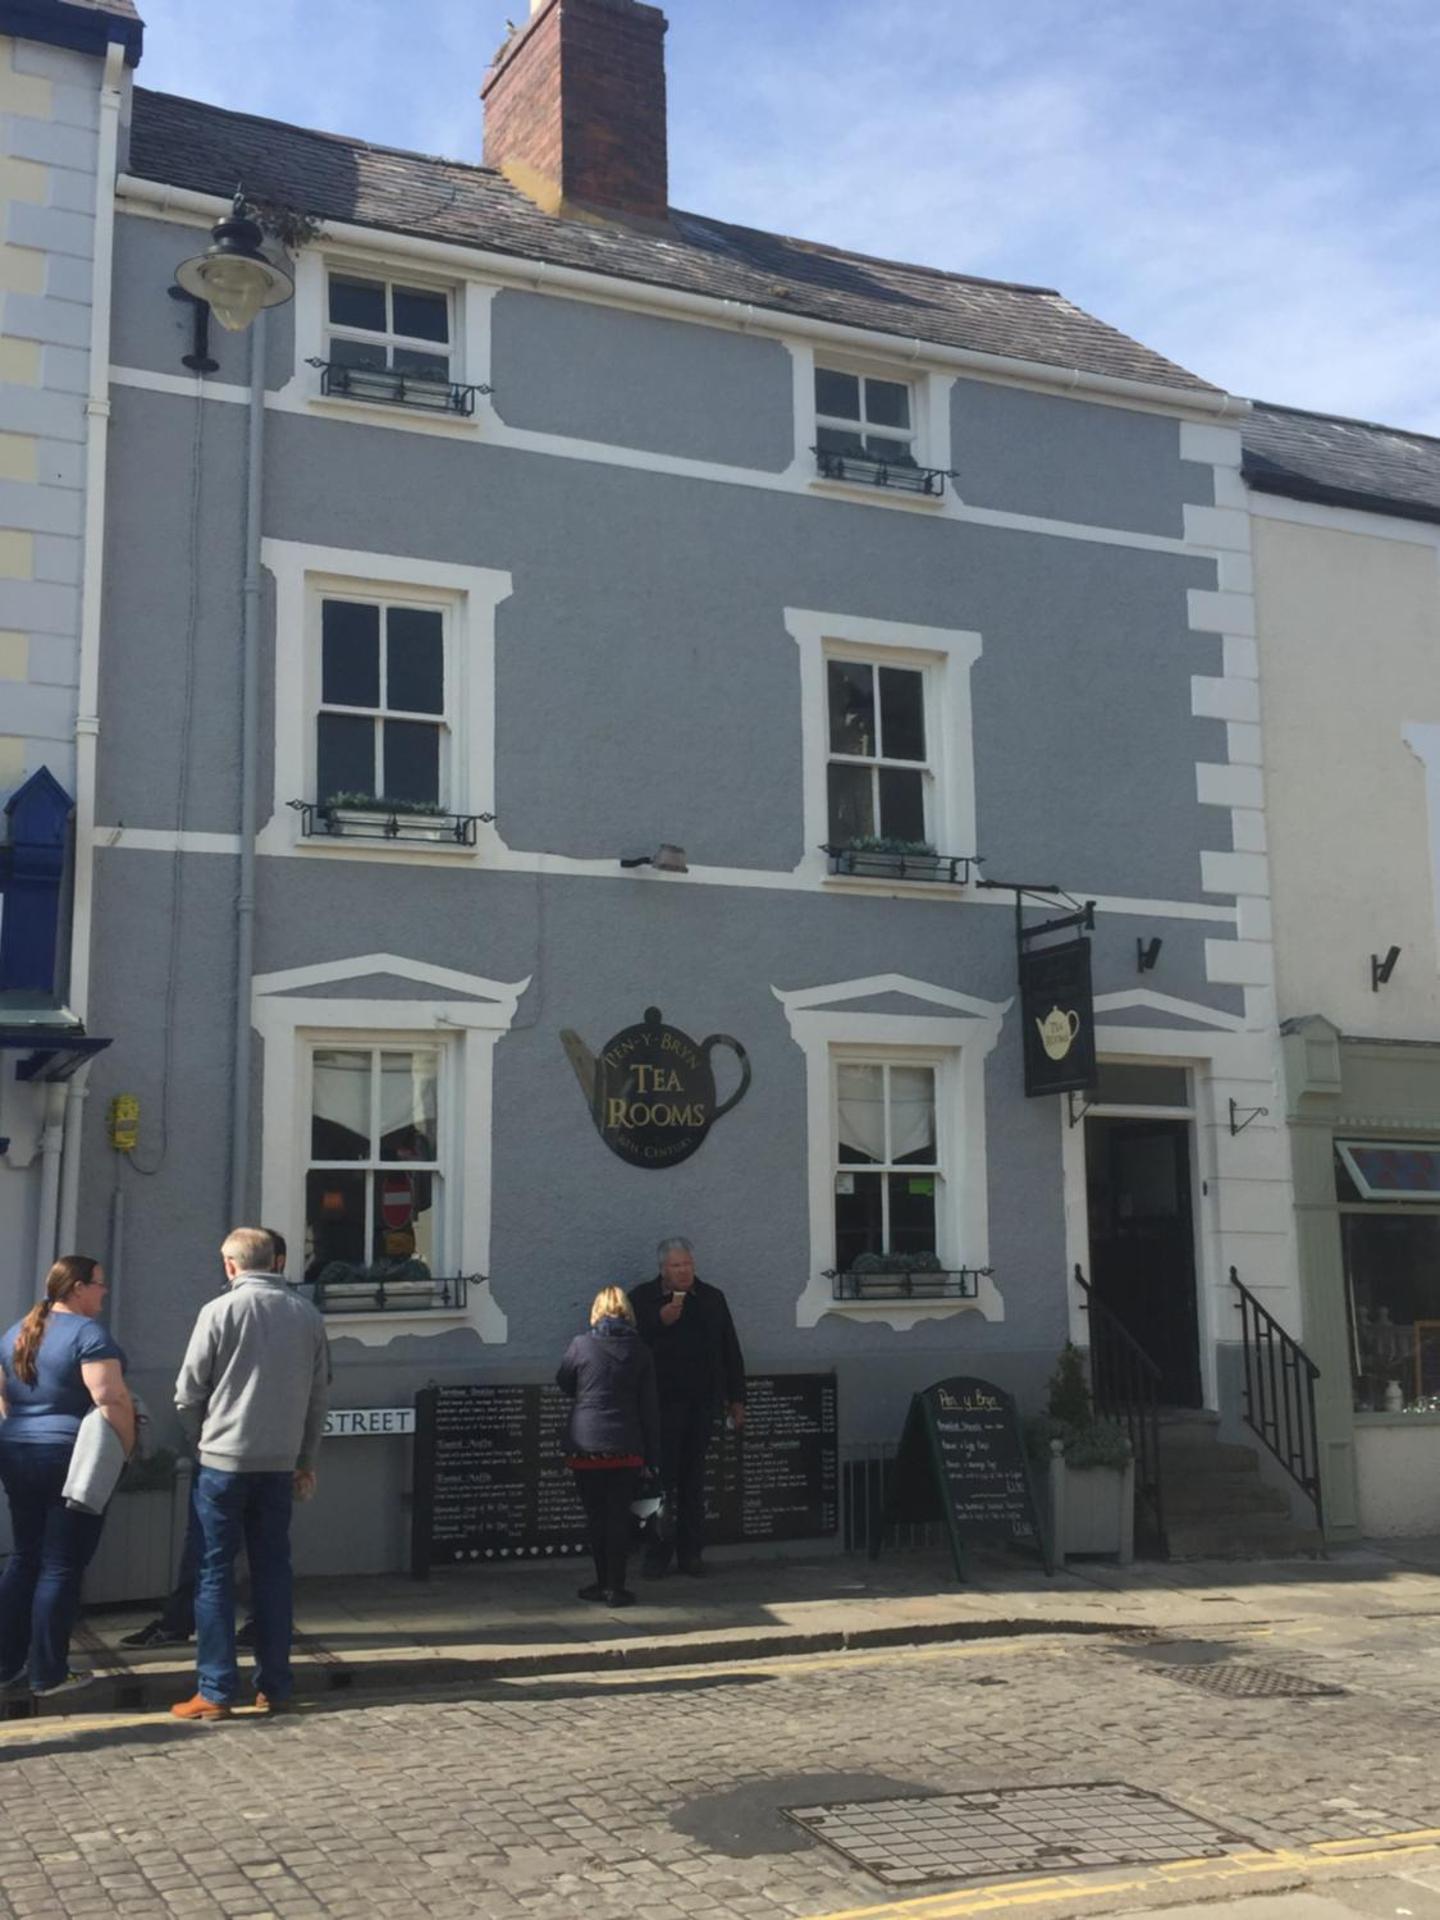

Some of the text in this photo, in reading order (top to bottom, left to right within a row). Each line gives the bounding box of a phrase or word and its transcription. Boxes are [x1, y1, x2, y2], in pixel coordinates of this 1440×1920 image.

[630, 1063, 684, 1094] TEA
[606, 1097, 705, 1129] ROOMS
[321, 1410, 411, 1433] STREET
